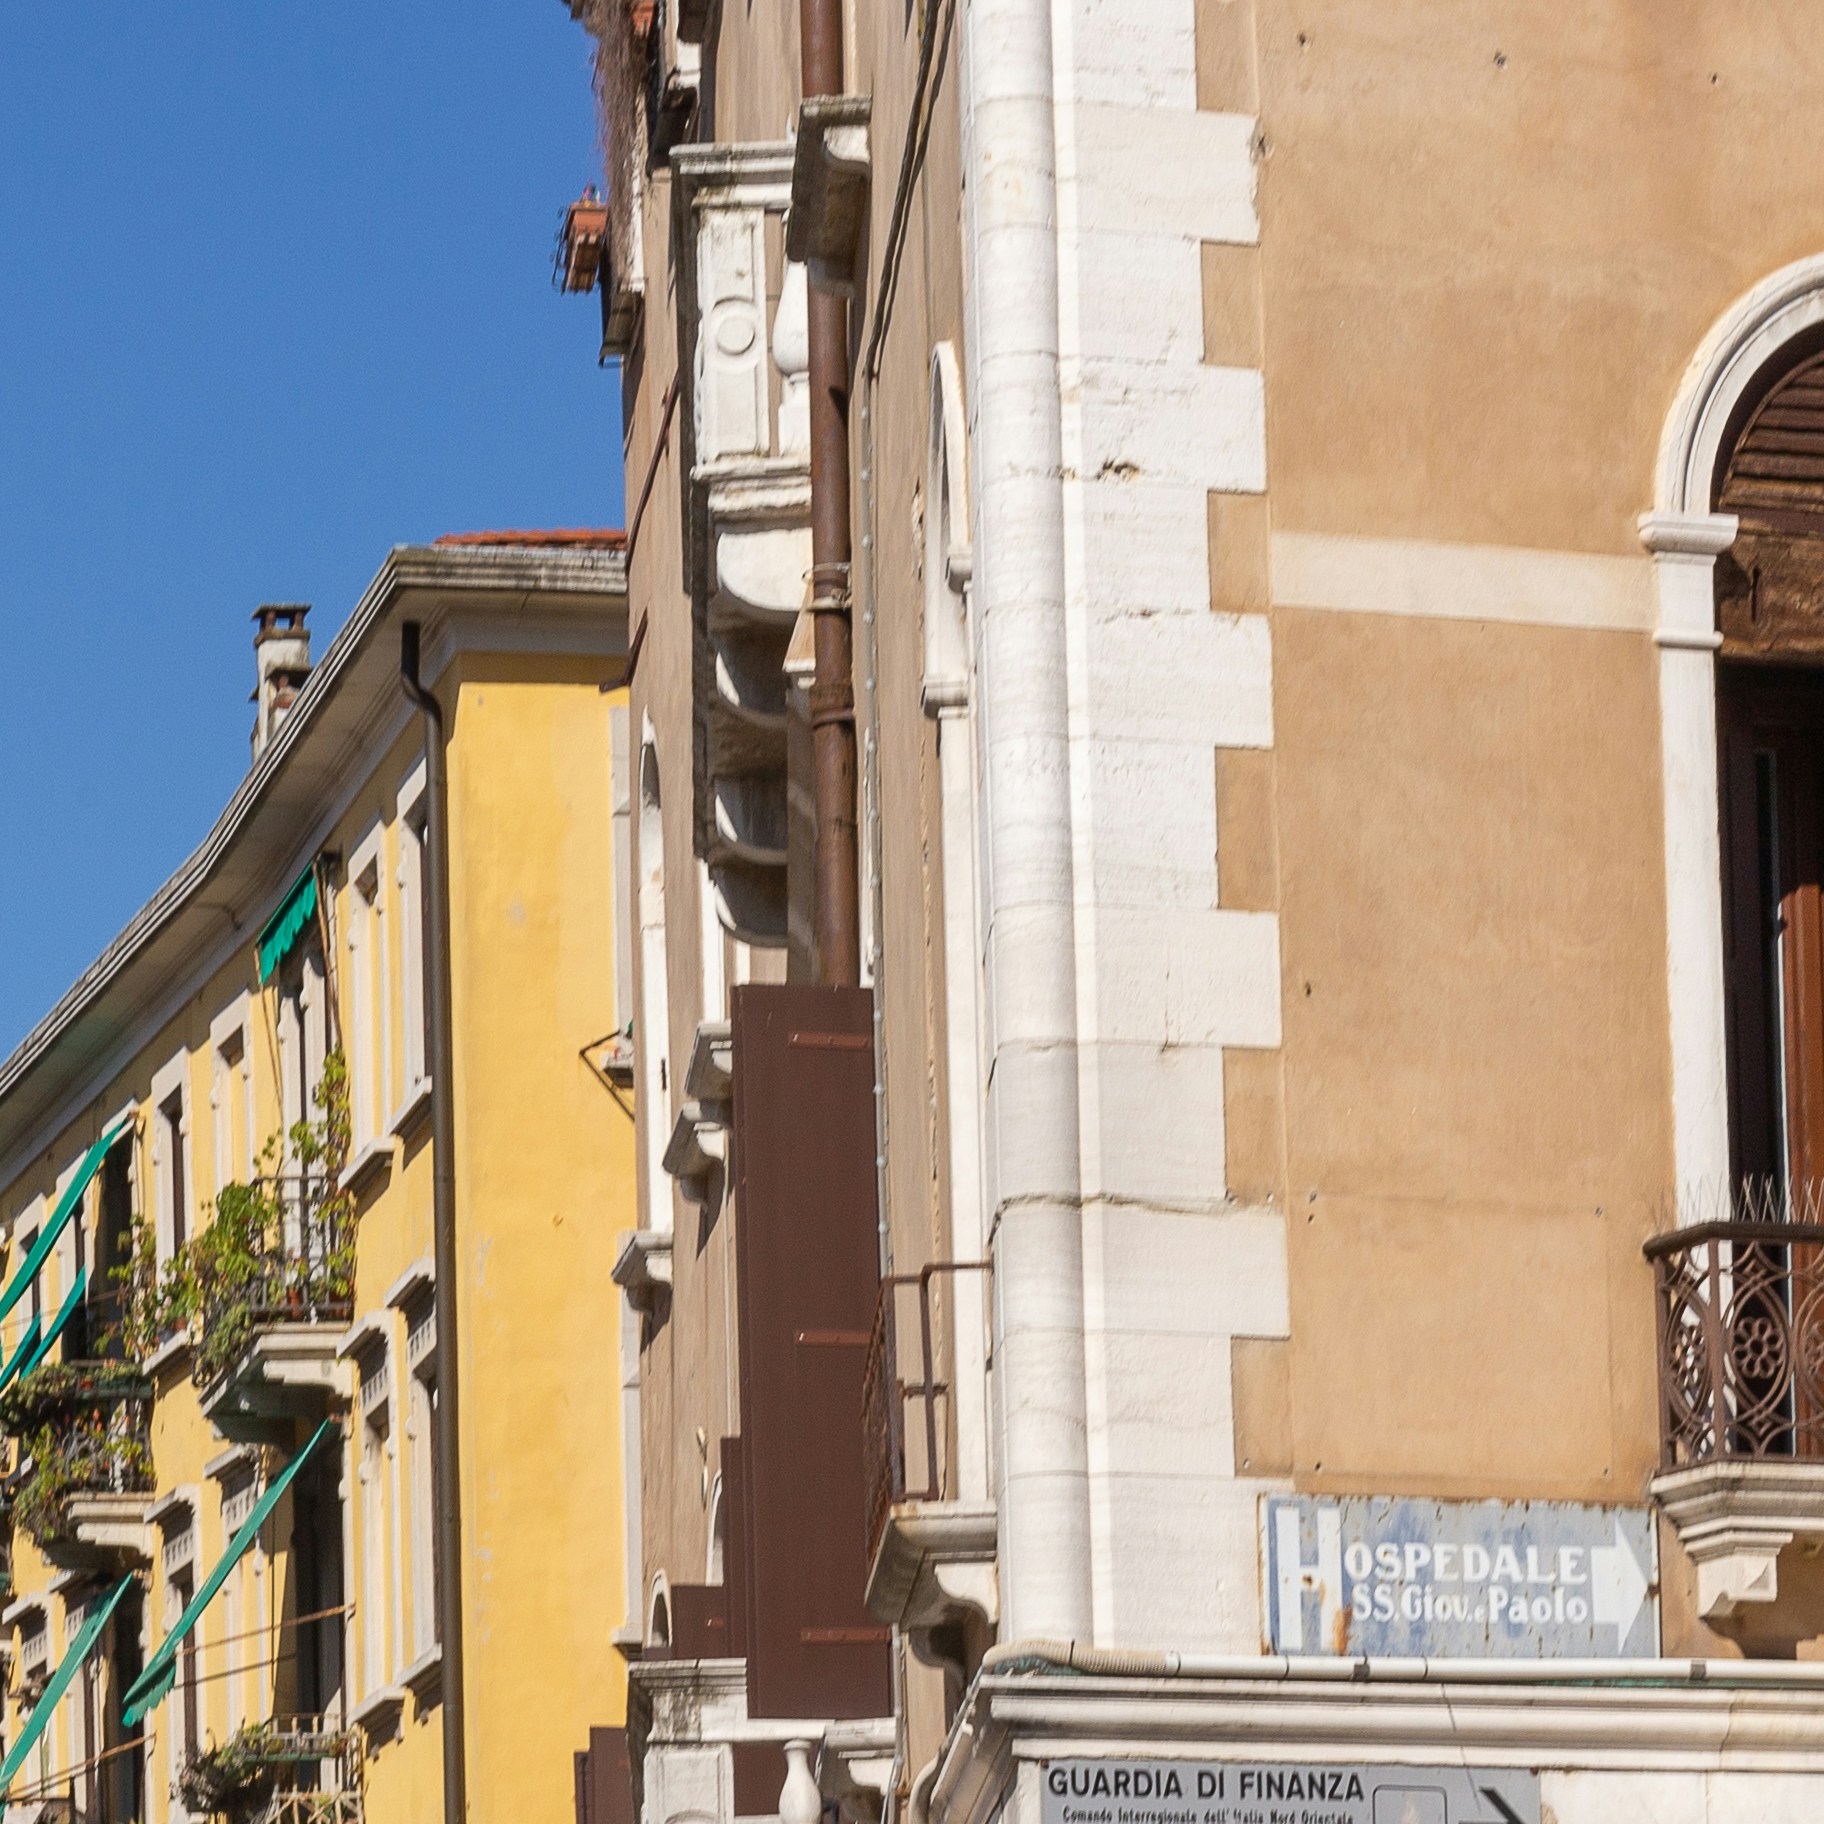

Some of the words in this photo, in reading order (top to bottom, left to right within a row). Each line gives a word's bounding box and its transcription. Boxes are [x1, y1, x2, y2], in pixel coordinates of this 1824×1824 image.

[1488, 1584, 1589, 1625] Paolo
[1049, 1768, 1183, 1799] GUARDIA
[1197, 1769, 1225, 1800] DI
[1239, 1771, 1365, 1801] FINANZA
[1062, 1806, 1113, 1824] Comando
